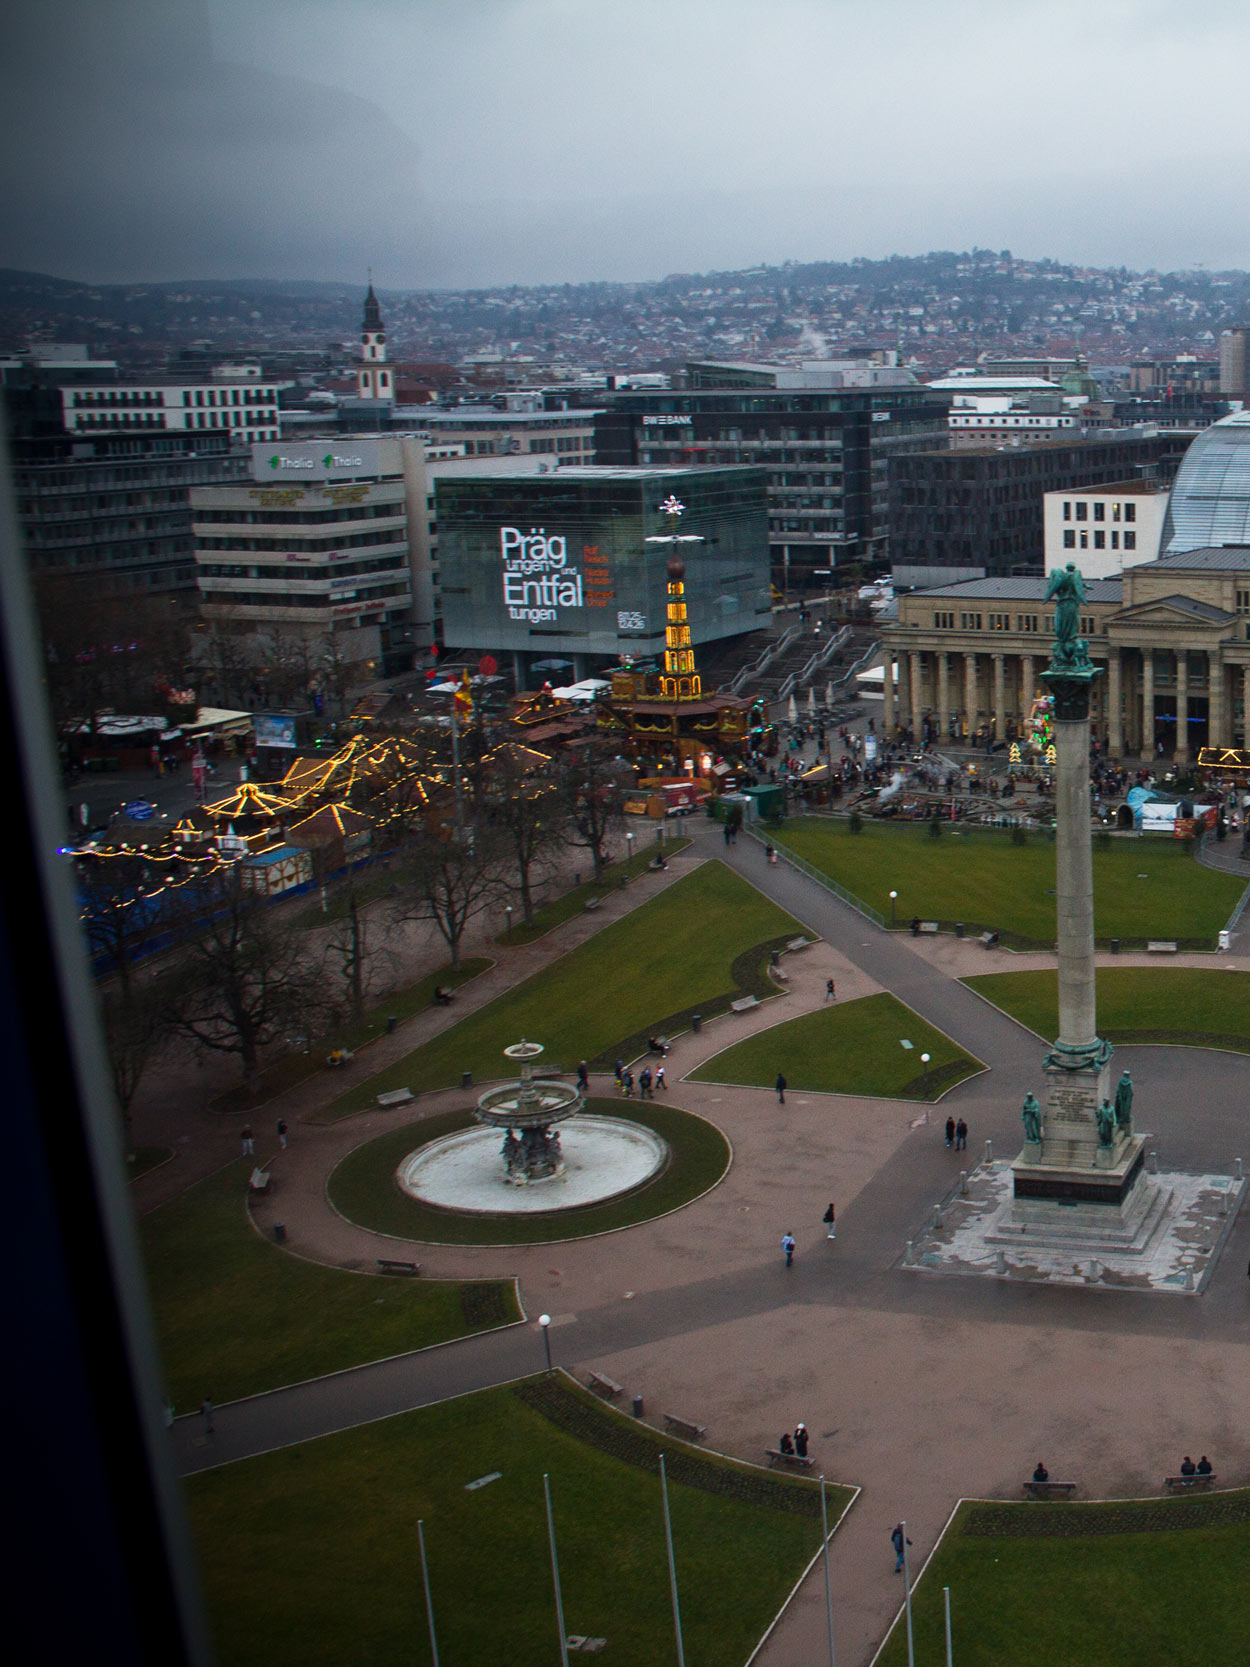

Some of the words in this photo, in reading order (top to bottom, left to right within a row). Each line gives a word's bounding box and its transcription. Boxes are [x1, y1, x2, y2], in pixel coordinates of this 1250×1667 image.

[280, 457, 314, 469] Thalia
[333, 456, 362, 467] Thalia
[501, 527, 567, 569] Präg
[506, 559, 550, 575] ungen
[561, 566, 577, 575] und
[503, 572, 583, 607] Entfal
[508, 605, 558, 623] tungen
